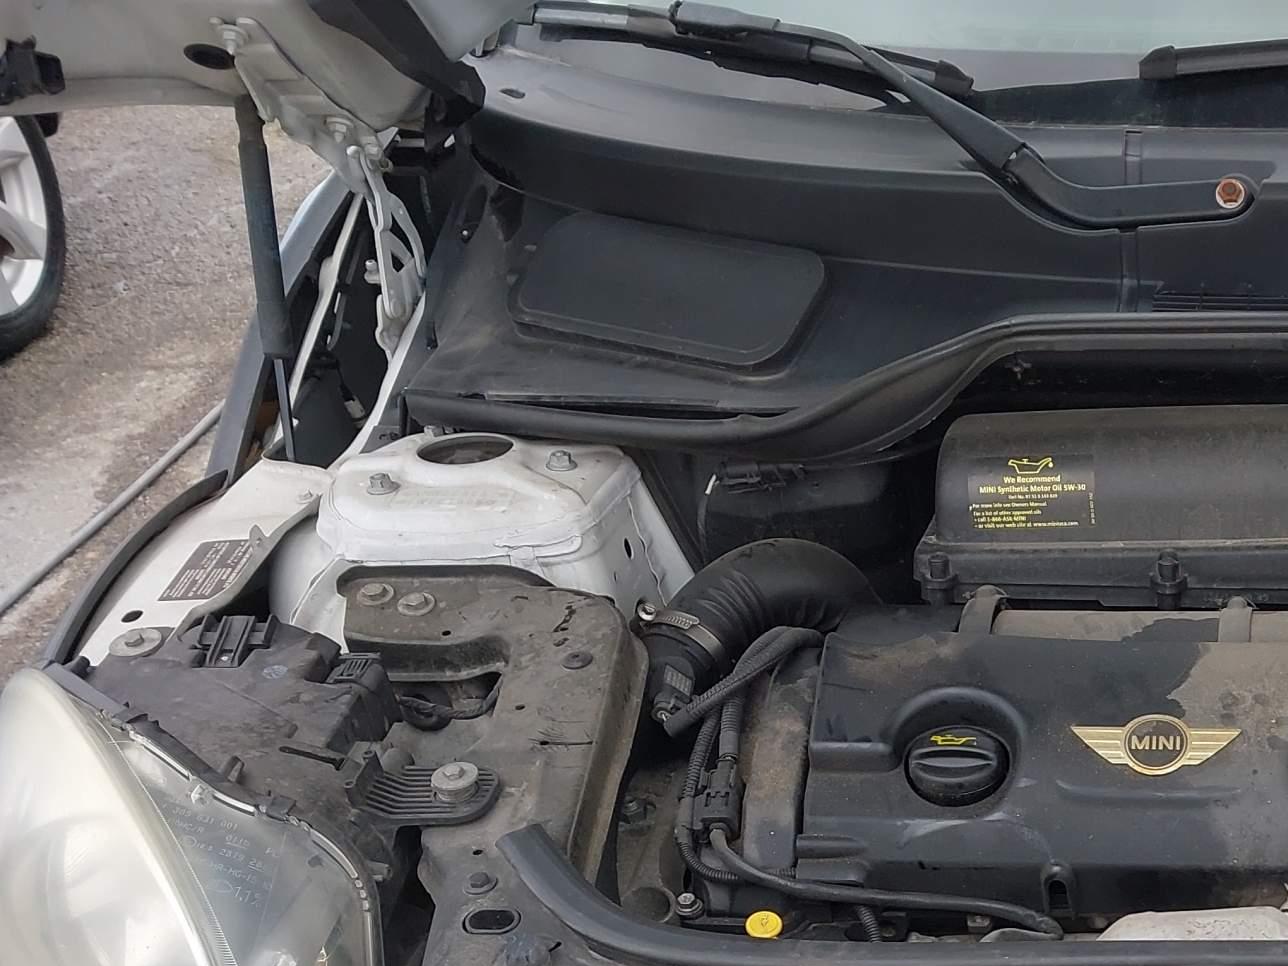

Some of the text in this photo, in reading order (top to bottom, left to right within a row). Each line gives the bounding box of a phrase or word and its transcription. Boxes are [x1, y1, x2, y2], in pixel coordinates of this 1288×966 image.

[1003, 474, 1061, 484] We Recommend
[979, 486, 997, 494] MINI
[997, 485, 1029, 495] Synthetic
[1030, 485, 1051, 493] Motor
[1063, 483, 1086, 491] 5W-30
[1131, 735, 1181, 750] MINI
